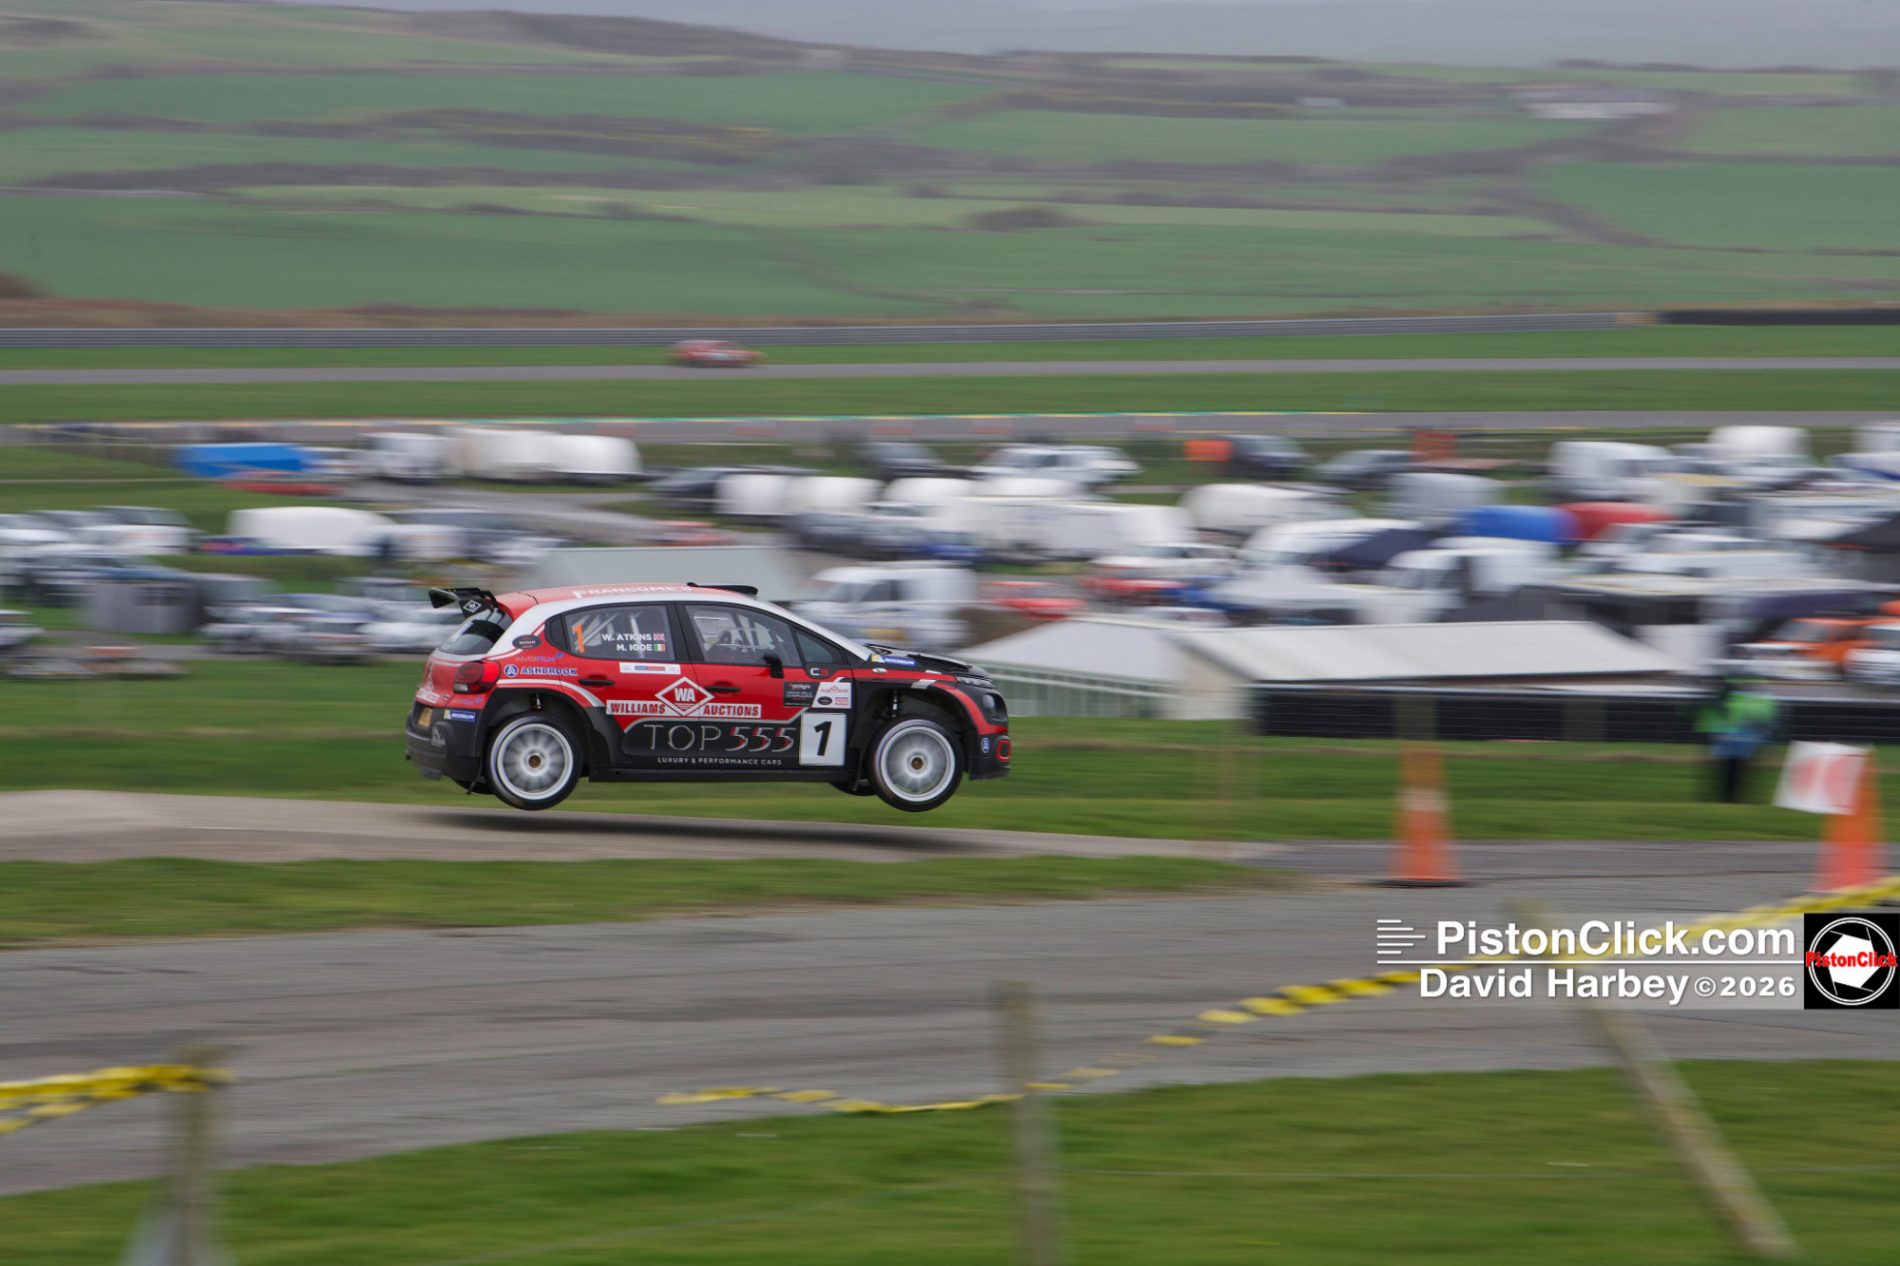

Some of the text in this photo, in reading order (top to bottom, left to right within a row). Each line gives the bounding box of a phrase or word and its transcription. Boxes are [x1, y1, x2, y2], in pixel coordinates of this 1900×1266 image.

[572, 624, 585, 653] 1
[617, 633, 652, 641] ATKINS
[629, 643, 653, 651] IGOE
[520, 665, 578, 677] ASHBROOK
[674, 687, 696, 702] WA
[610, 702, 759, 716] WILLIAMS AUCTIONS
[643, 724, 797, 752] TOP 555
[814, 721, 832, 756] 1
[698, 757, 758, 765] PERFORMANCE
